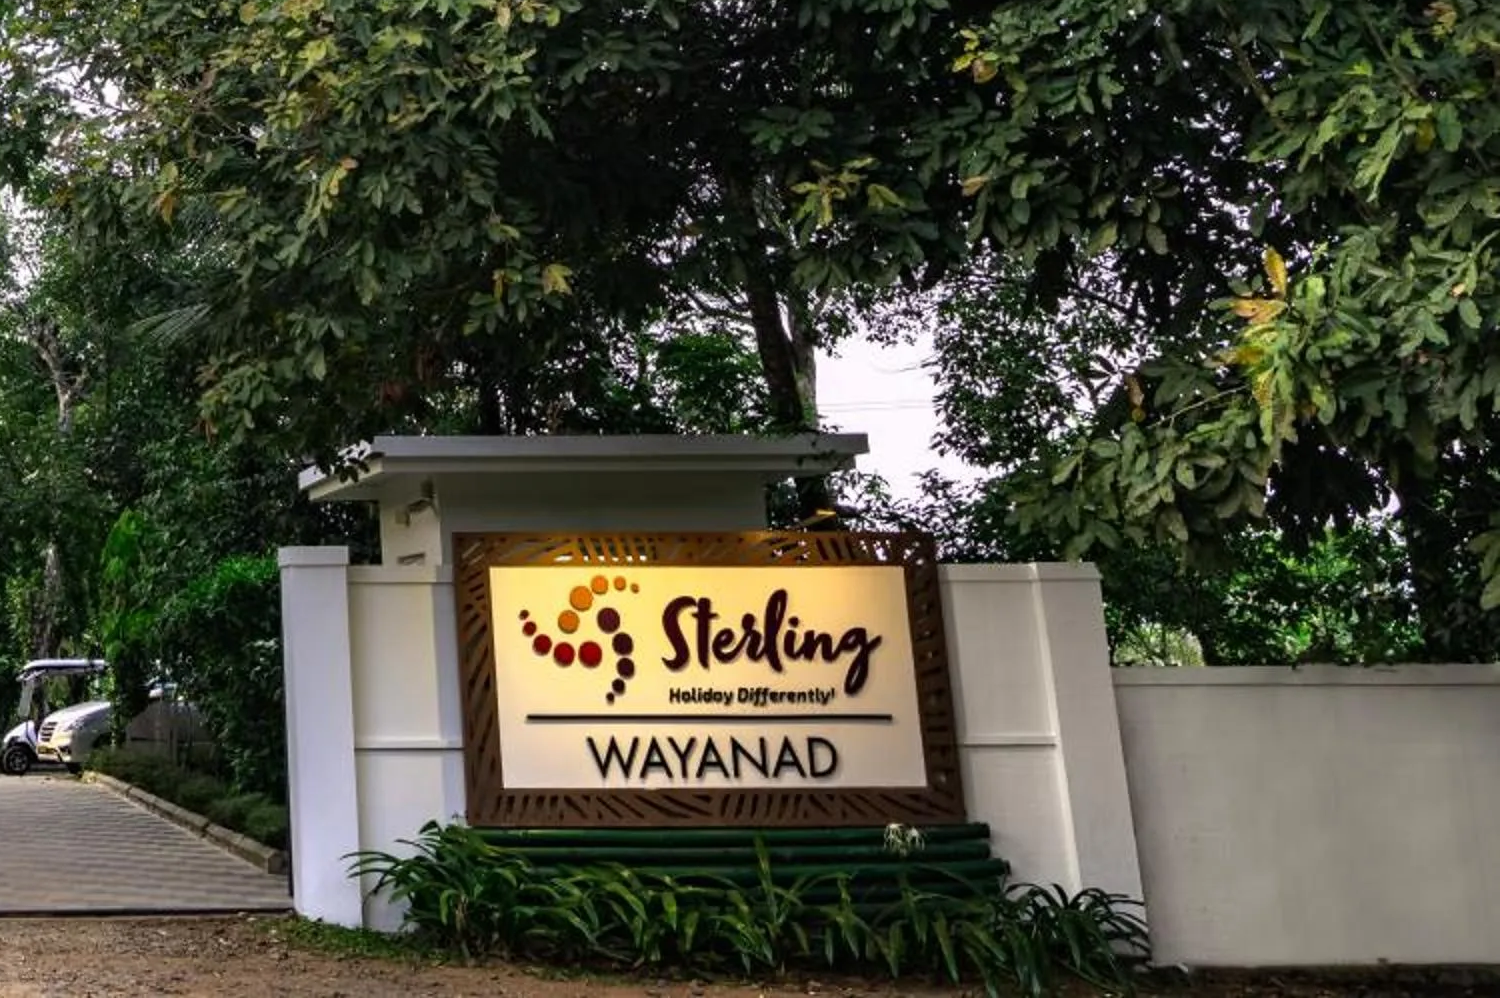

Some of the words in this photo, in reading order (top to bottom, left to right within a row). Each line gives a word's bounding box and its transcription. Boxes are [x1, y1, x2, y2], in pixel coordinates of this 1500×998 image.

[661, 588, 881, 695] Sterling
[669, 687, 733, 706] Holiday
[737, 687, 836, 707] Differently!
[587, 736, 838, 779] WAYANAD
